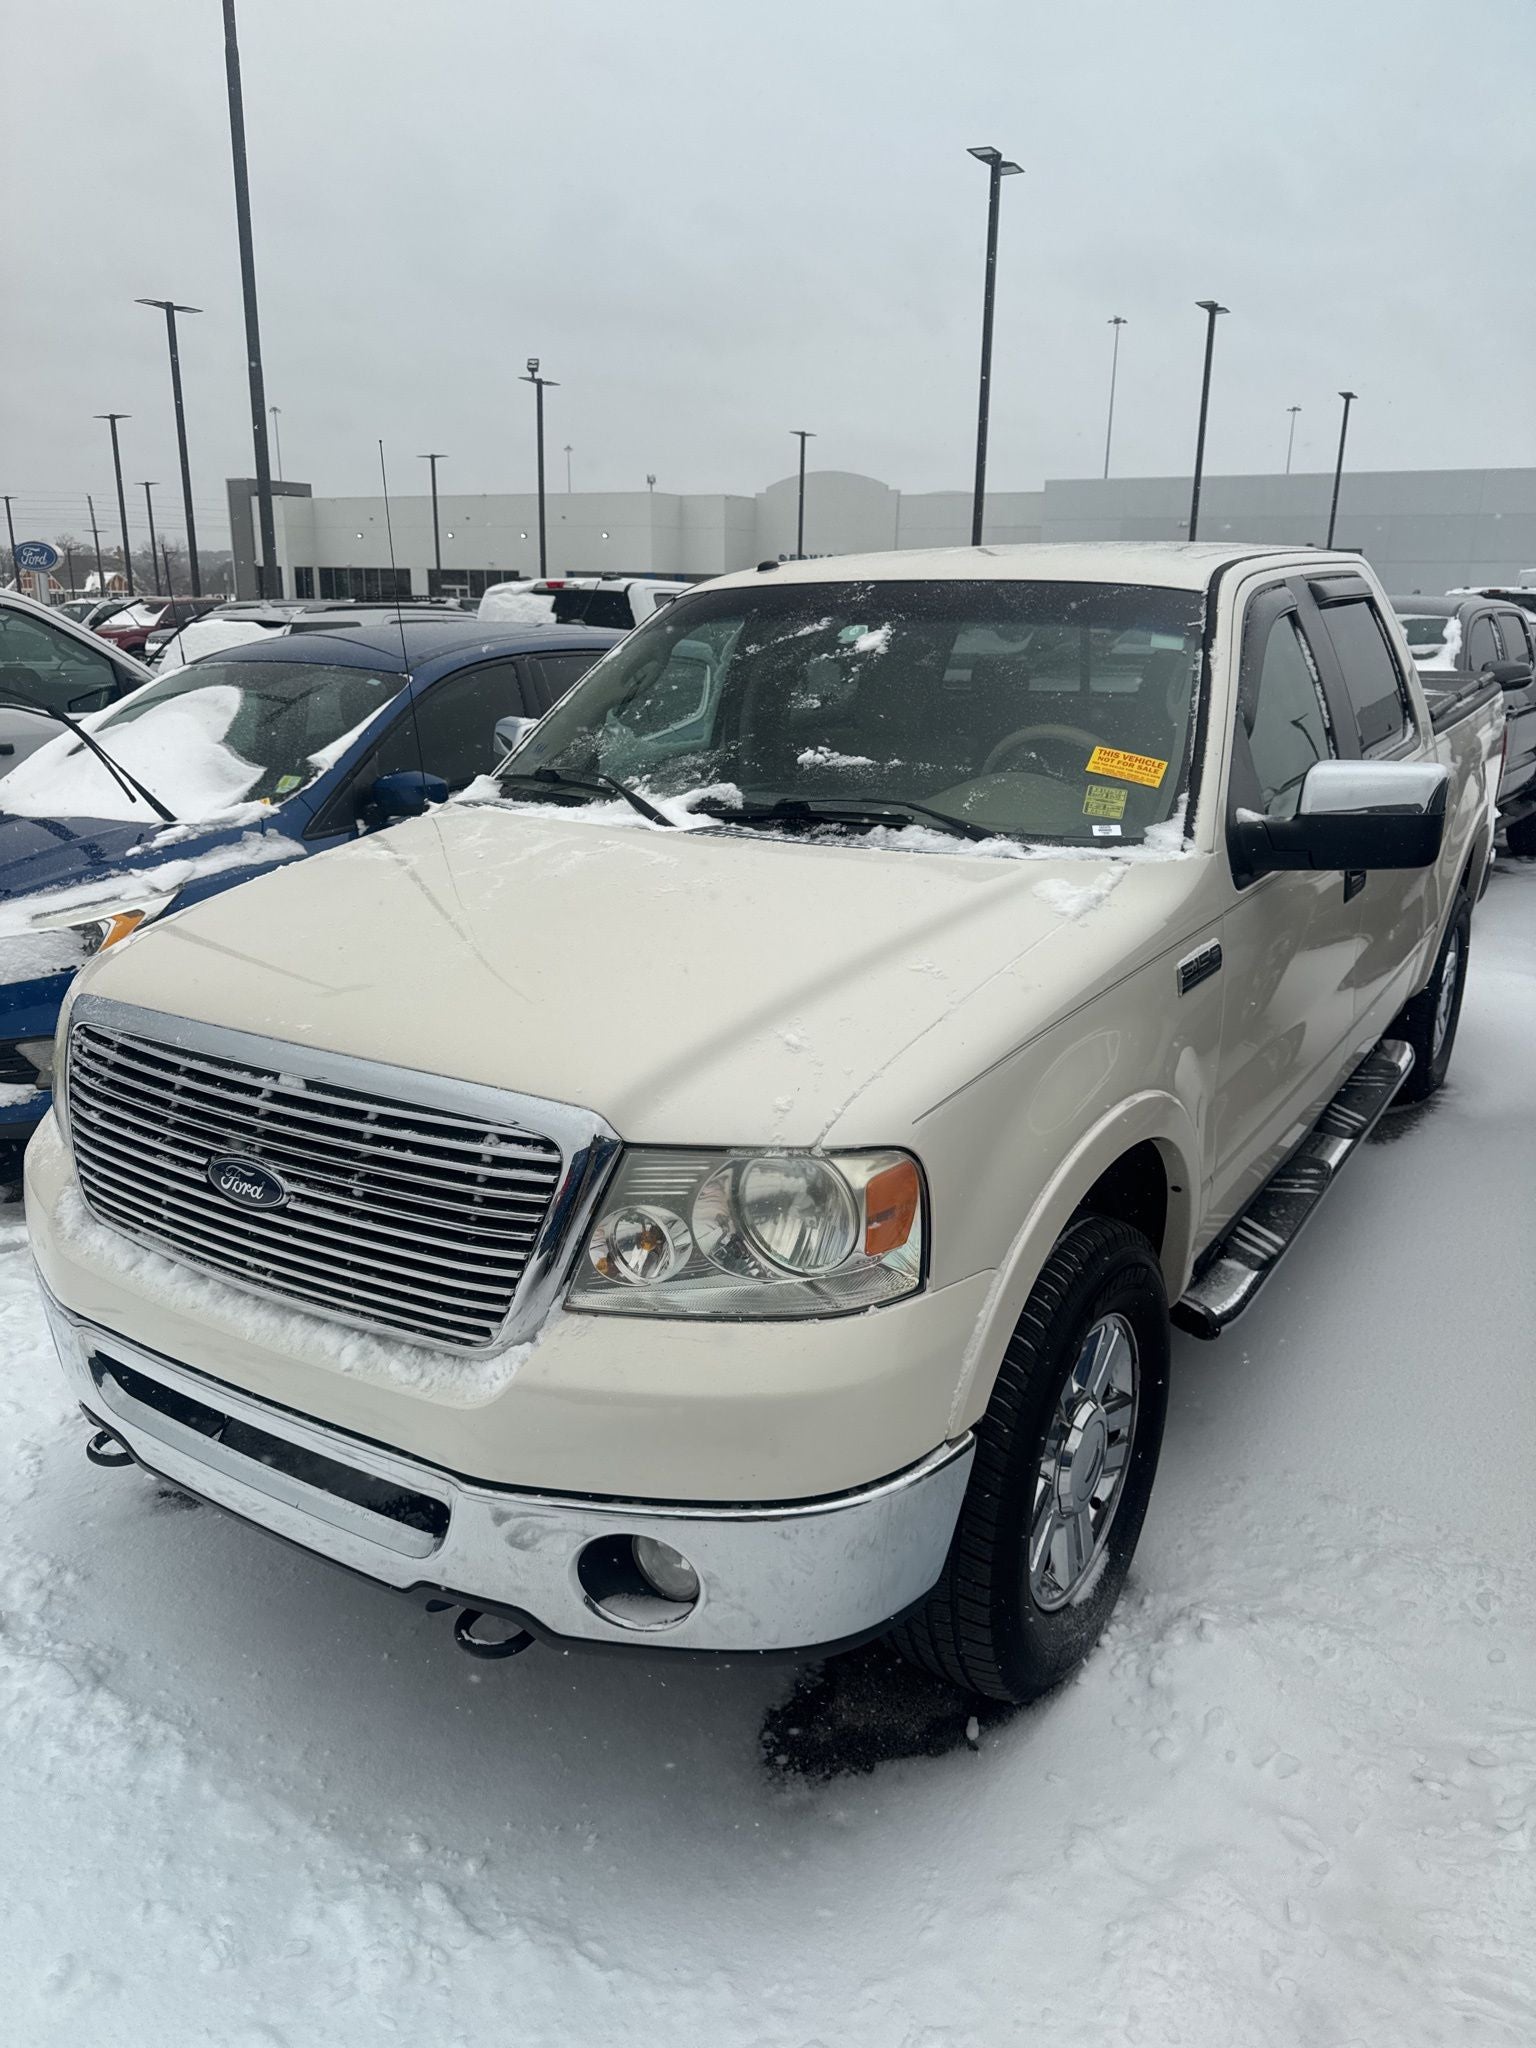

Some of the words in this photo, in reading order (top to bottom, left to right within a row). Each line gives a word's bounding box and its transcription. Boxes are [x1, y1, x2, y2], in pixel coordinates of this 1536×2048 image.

[21, 547, 48, 565] Ford
[1098, 749, 1120, 759] THIS
[1123, 754, 1165, 769] VEHICLE
[1117, 760, 1135, 768] FOR
[1137, 764, 1160, 774] SALE
[221, 1165, 265, 1199] Ford
